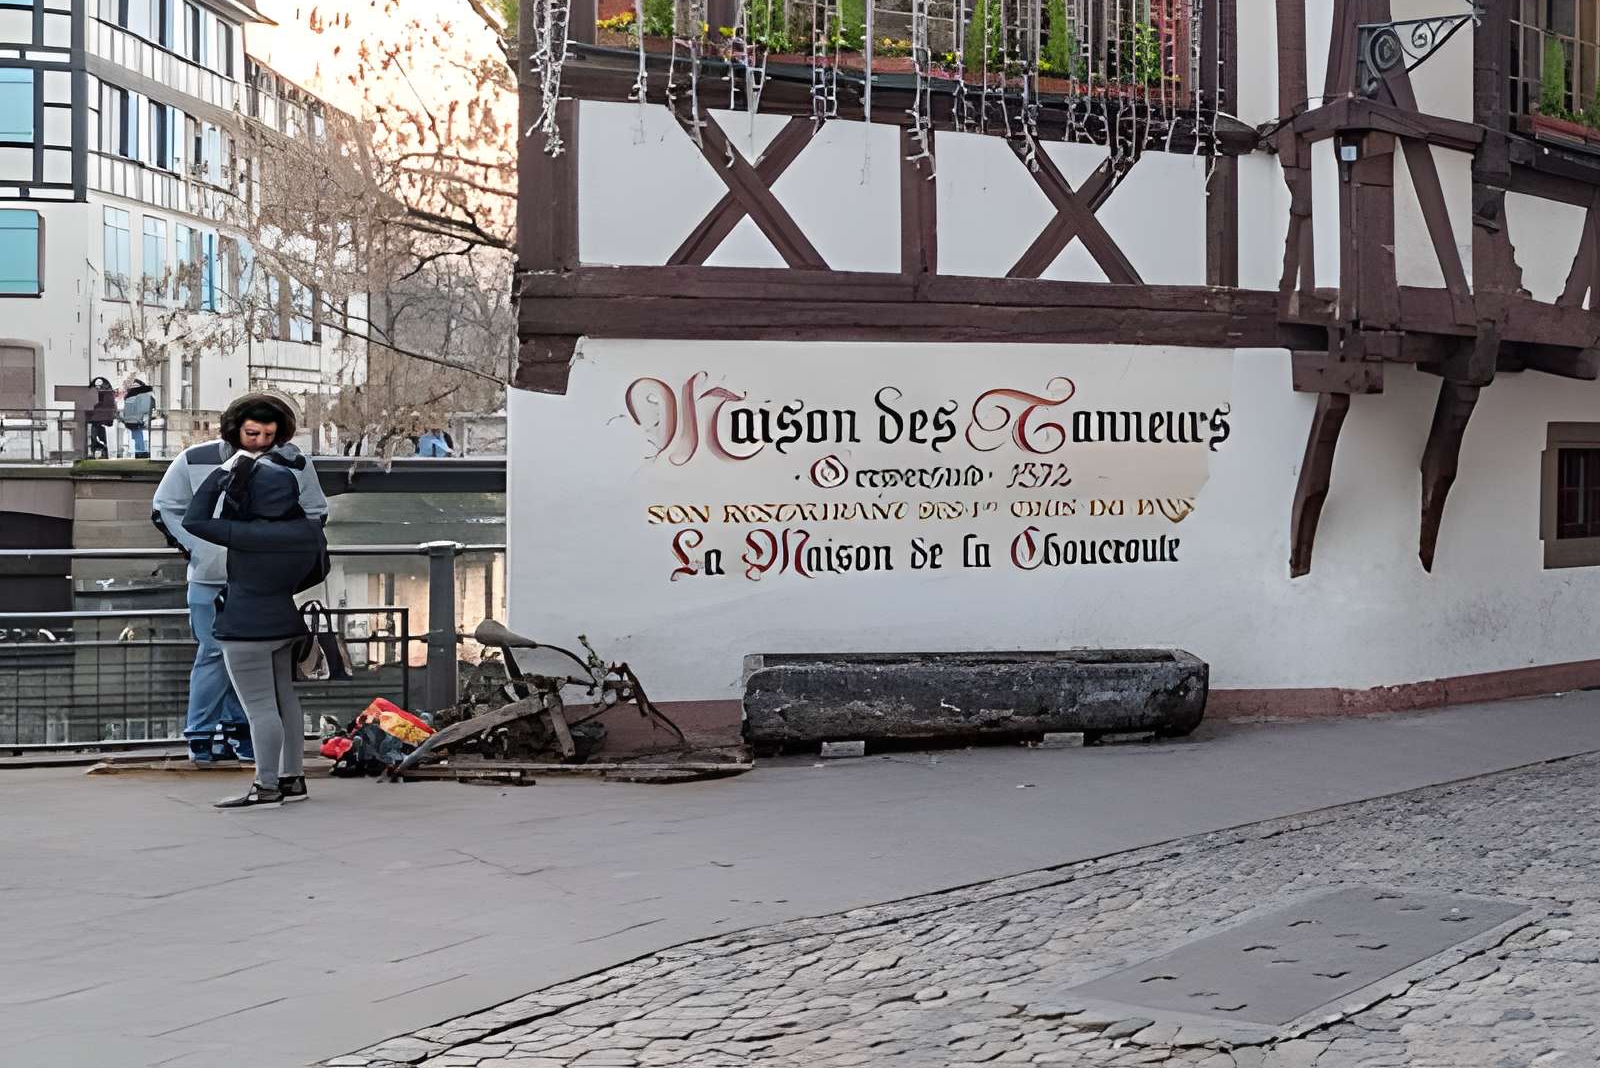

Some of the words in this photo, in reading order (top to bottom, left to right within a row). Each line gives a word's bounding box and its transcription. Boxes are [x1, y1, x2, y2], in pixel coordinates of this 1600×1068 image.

[625, 370, 861, 466] Maison
[874, 386, 959, 454] des
[964, 376, 1232, 455] Tanneurs
[670, 528, 726, 582] La
[741, 527, 894, 582] Maison
[910, 537, 944, 570] de
[962, 533, 992, 568] la
